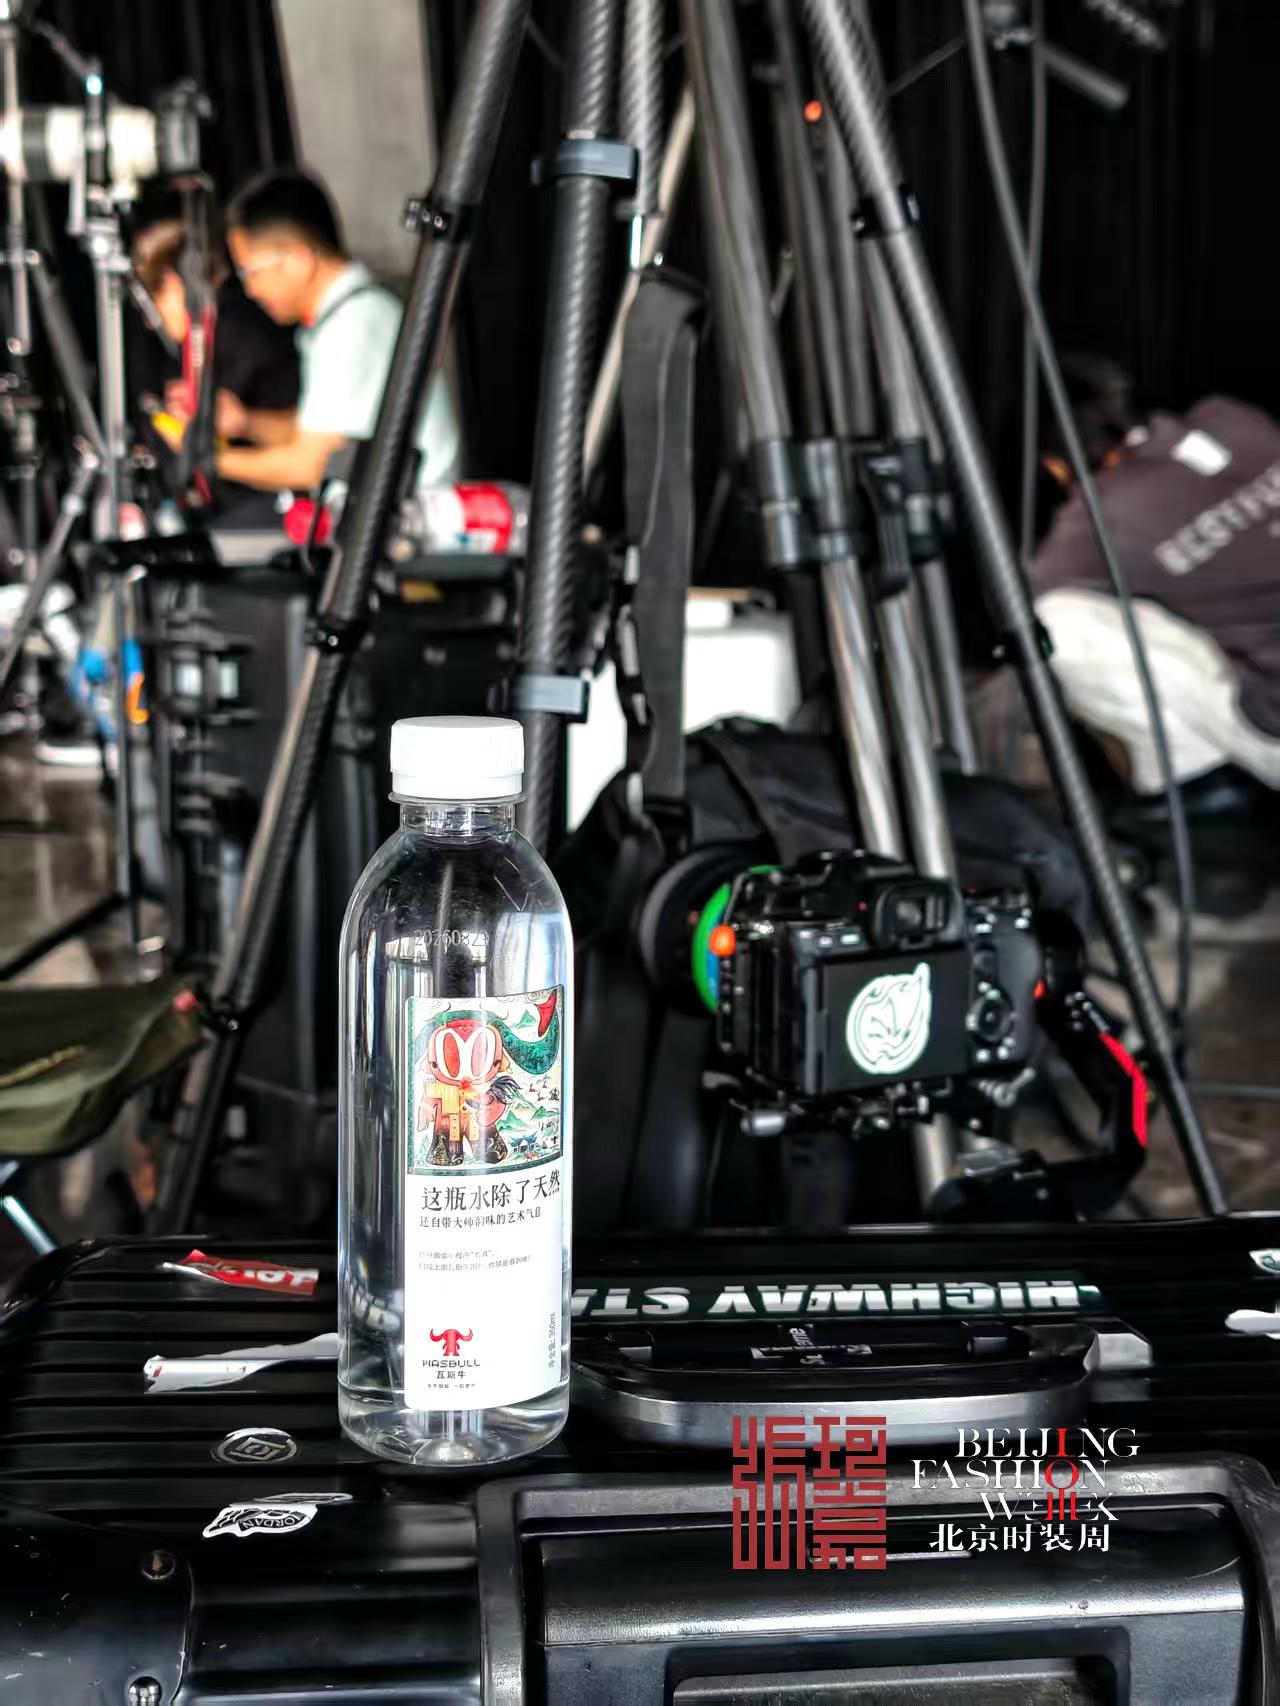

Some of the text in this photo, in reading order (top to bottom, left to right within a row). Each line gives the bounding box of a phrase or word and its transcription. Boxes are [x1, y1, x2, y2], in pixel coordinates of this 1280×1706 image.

[421, 1170, 560, 1212] 这瓶水除了天然
[707, 1280, 1080, 1314] HIGHWAY
[422, 1358, 481, 1368] WASBULL
[436, 1370, 467, 1380] 瓦斯牛
